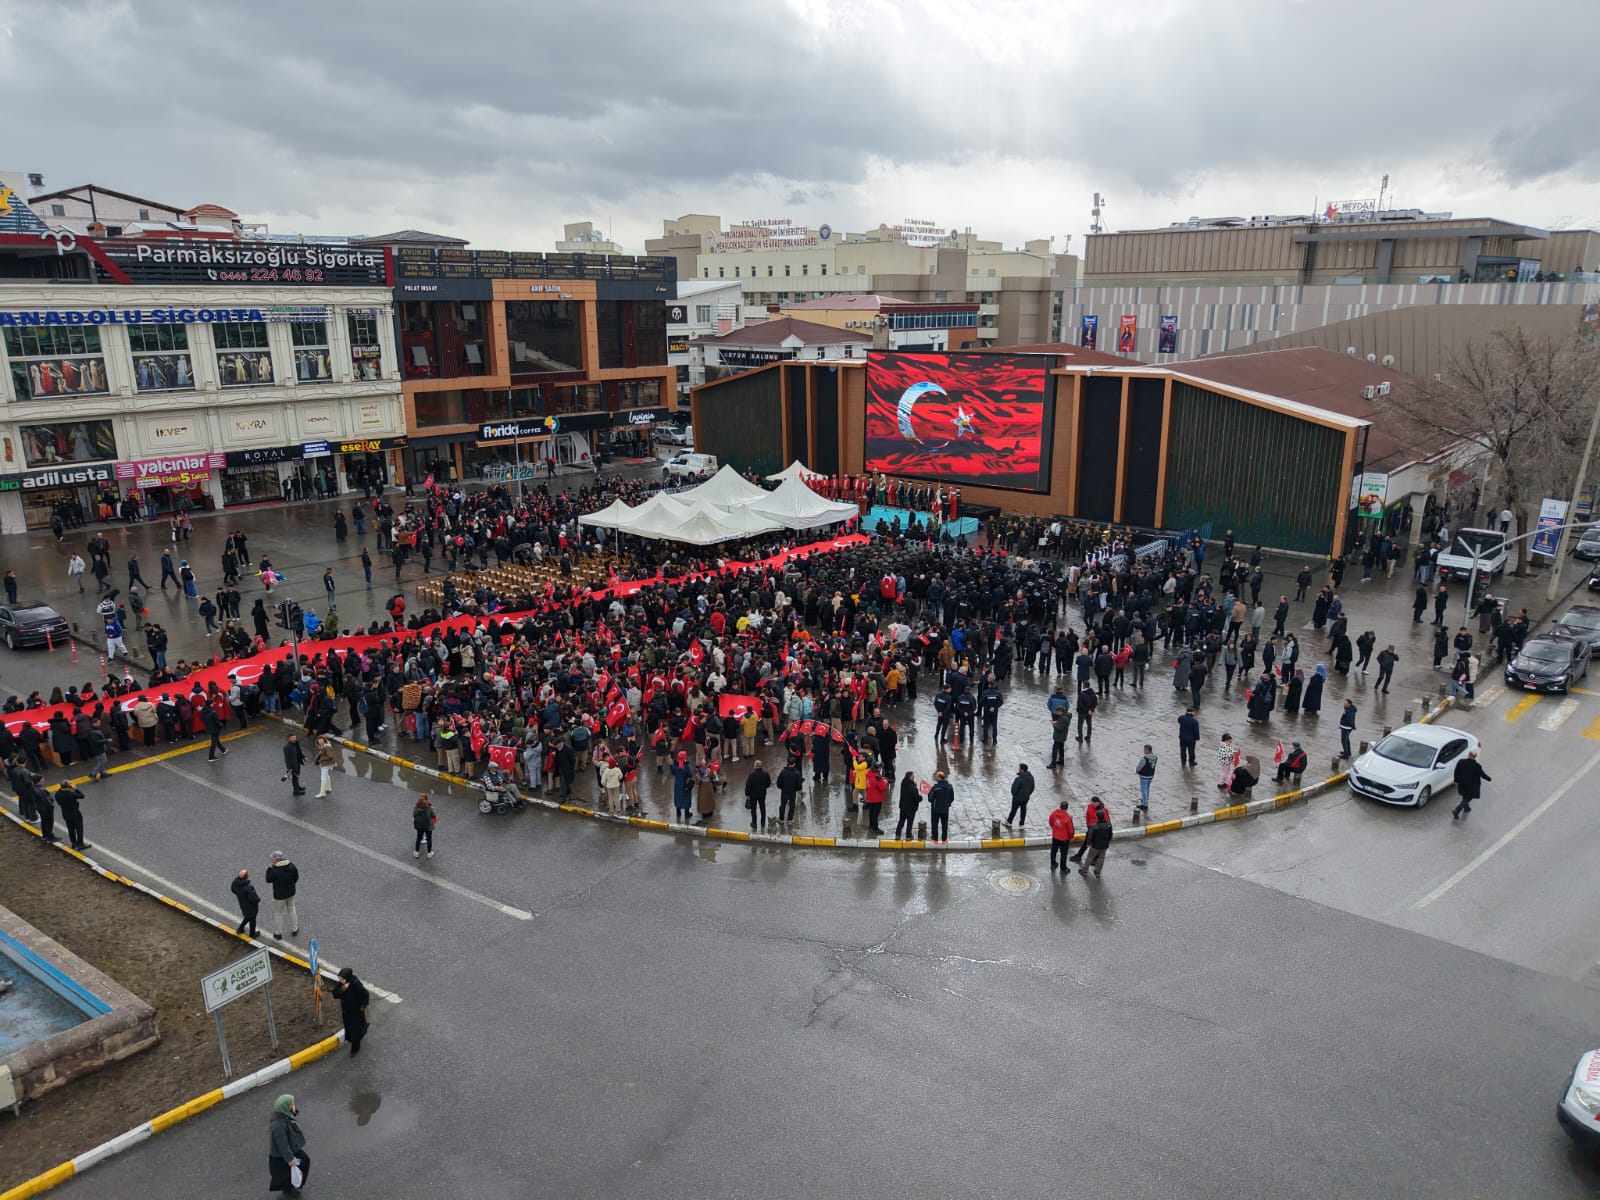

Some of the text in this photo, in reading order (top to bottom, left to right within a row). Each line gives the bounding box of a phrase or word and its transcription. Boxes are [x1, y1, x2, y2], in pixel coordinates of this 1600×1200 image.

[137, 244, 374, 268] Parmaksızoğlu Sigorta
[250, 268, 278, 281] 224
[282, 269, 302, 281] 46
[305, 269, 323, 281] 92
[0, 309, 142, 326] ANADOLU
[151, 305, 263, 323] SİGORTA
[483, 424, 519, 438] florida
[245, 450, 286, 459] ROYAL
[138, 457, 206, 477] yalçınlar
[22, 472, 60, 488] adil
[61, 468, 109, 484] usta
